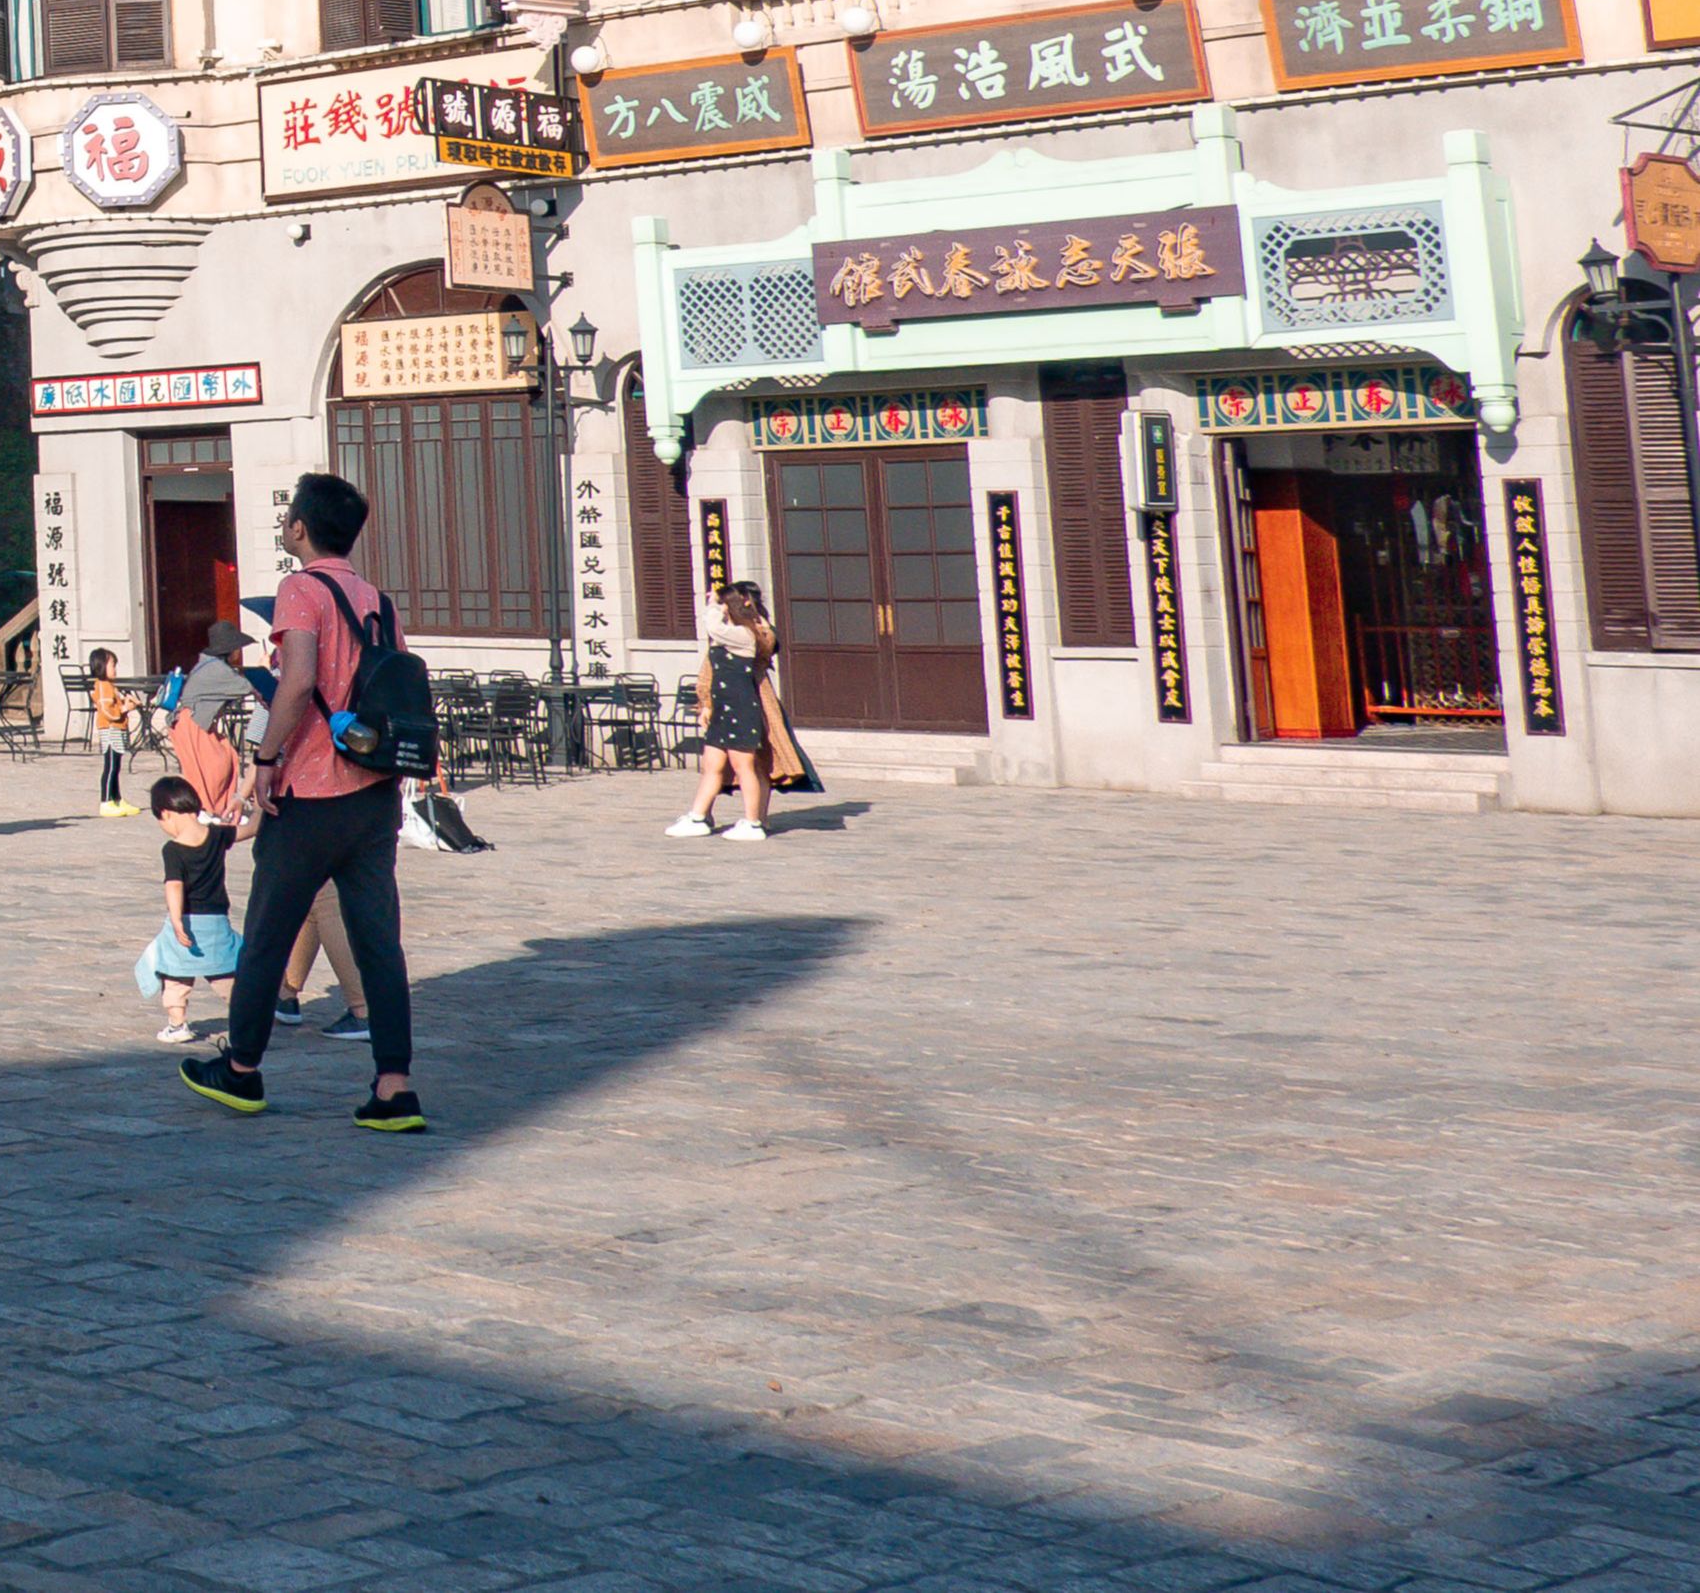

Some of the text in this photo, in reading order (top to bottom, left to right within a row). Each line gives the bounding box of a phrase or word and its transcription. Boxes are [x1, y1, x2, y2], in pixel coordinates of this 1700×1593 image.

[82, 120, 149, 186] 福
[283, 168, 329, 185] FOOK
[45, 492, 70, 660] 福源號錢莊
